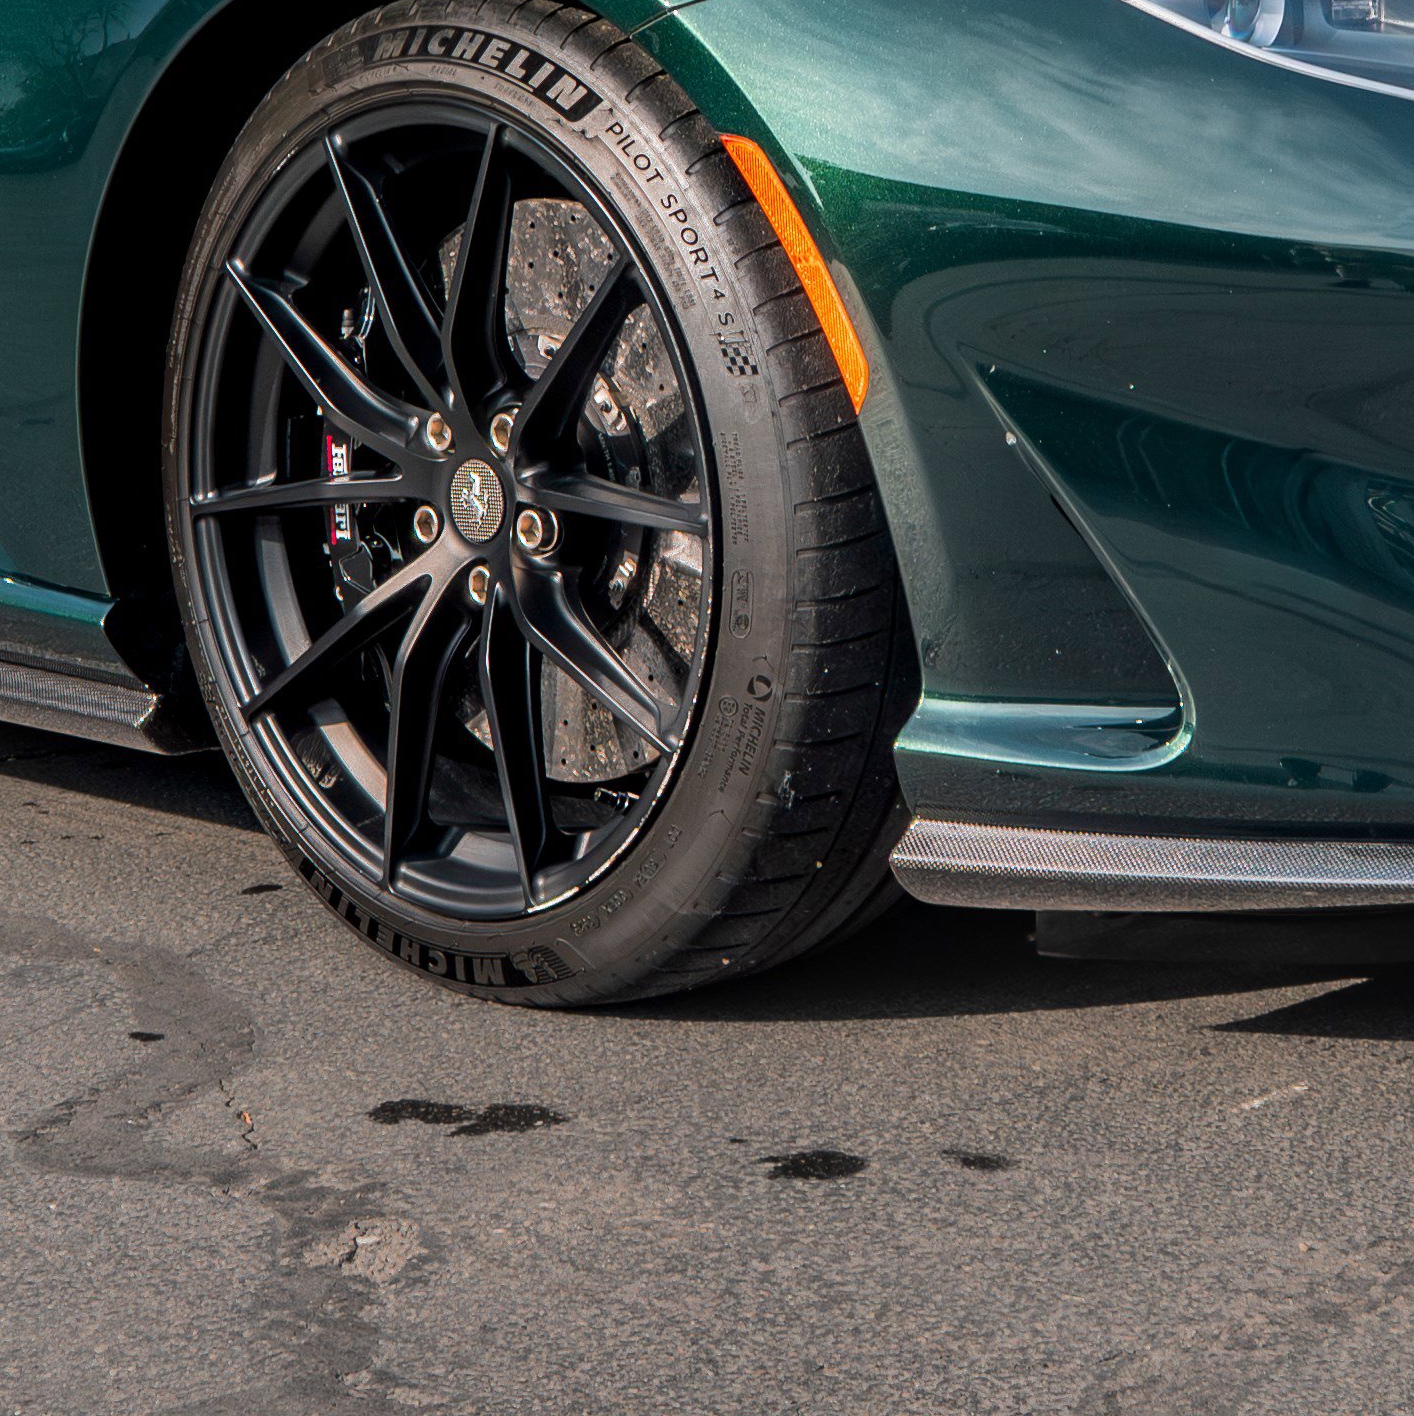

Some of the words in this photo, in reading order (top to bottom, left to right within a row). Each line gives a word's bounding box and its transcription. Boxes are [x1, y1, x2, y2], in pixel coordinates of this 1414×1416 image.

[372, 27, 587, 111] MICHELIN
[605, 121, 665, 184] PILOT
[660, 192, 720, 285] SPORT
[712, 287, 727, 301] 4
[717, 311, 736, 327] S
[331, 442, 352, 541] Feari
[738, 706, 766, 777] MICHELIN
[310, 868, 506, 986] MICHELIN
